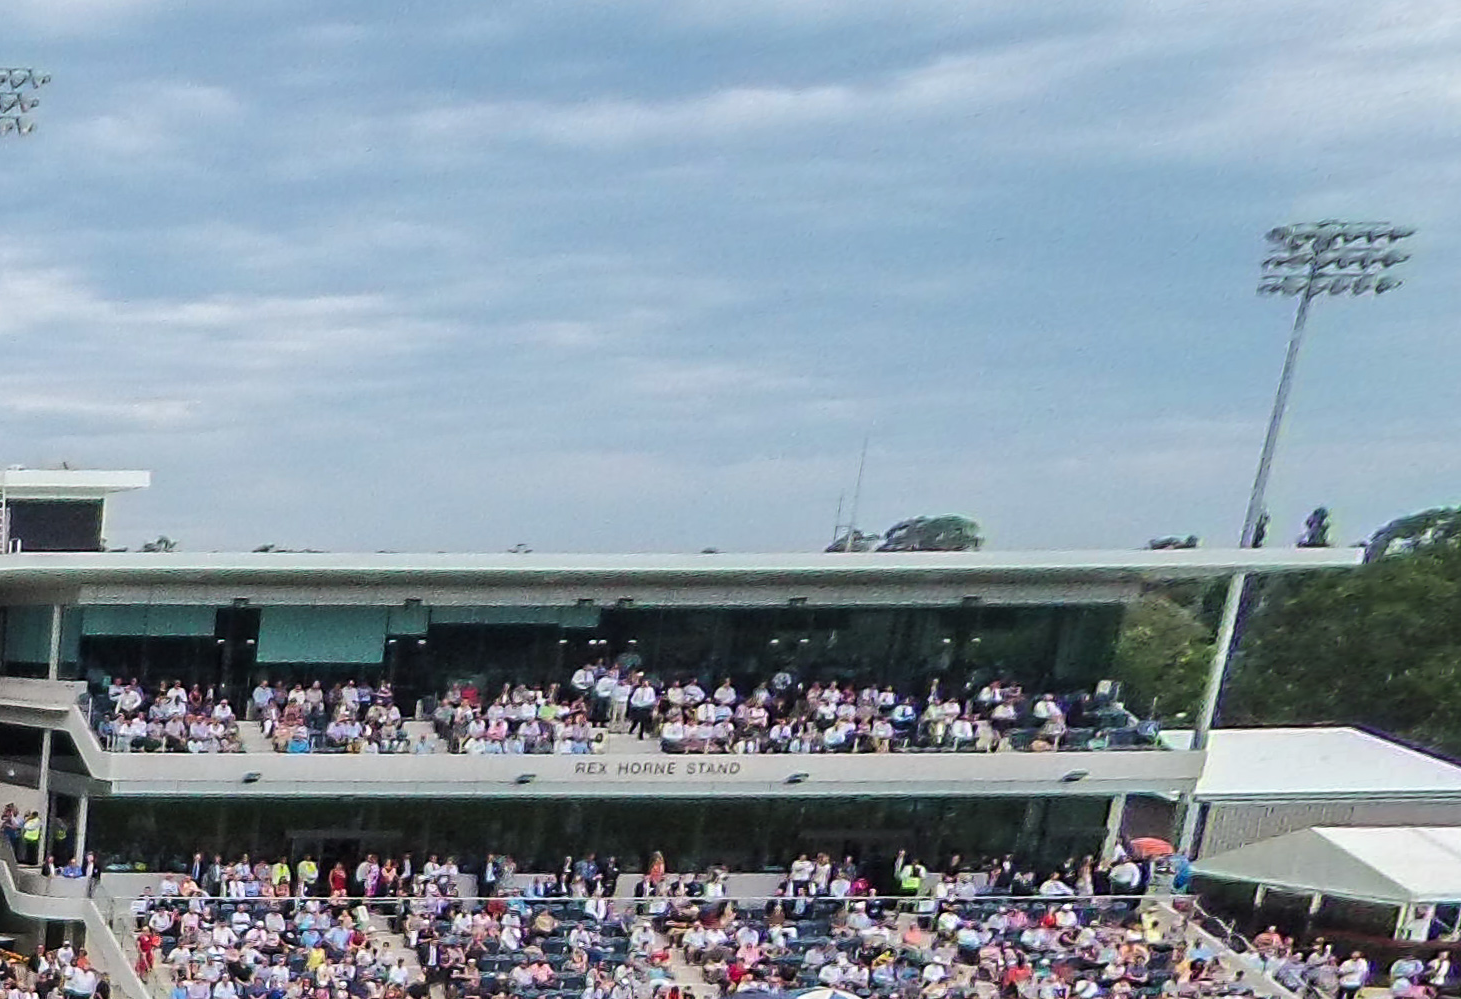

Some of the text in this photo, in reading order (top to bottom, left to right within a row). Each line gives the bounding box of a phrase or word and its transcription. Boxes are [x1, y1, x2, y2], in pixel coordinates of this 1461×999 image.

[574, 761, 741, 775] REX HORNE STAND
